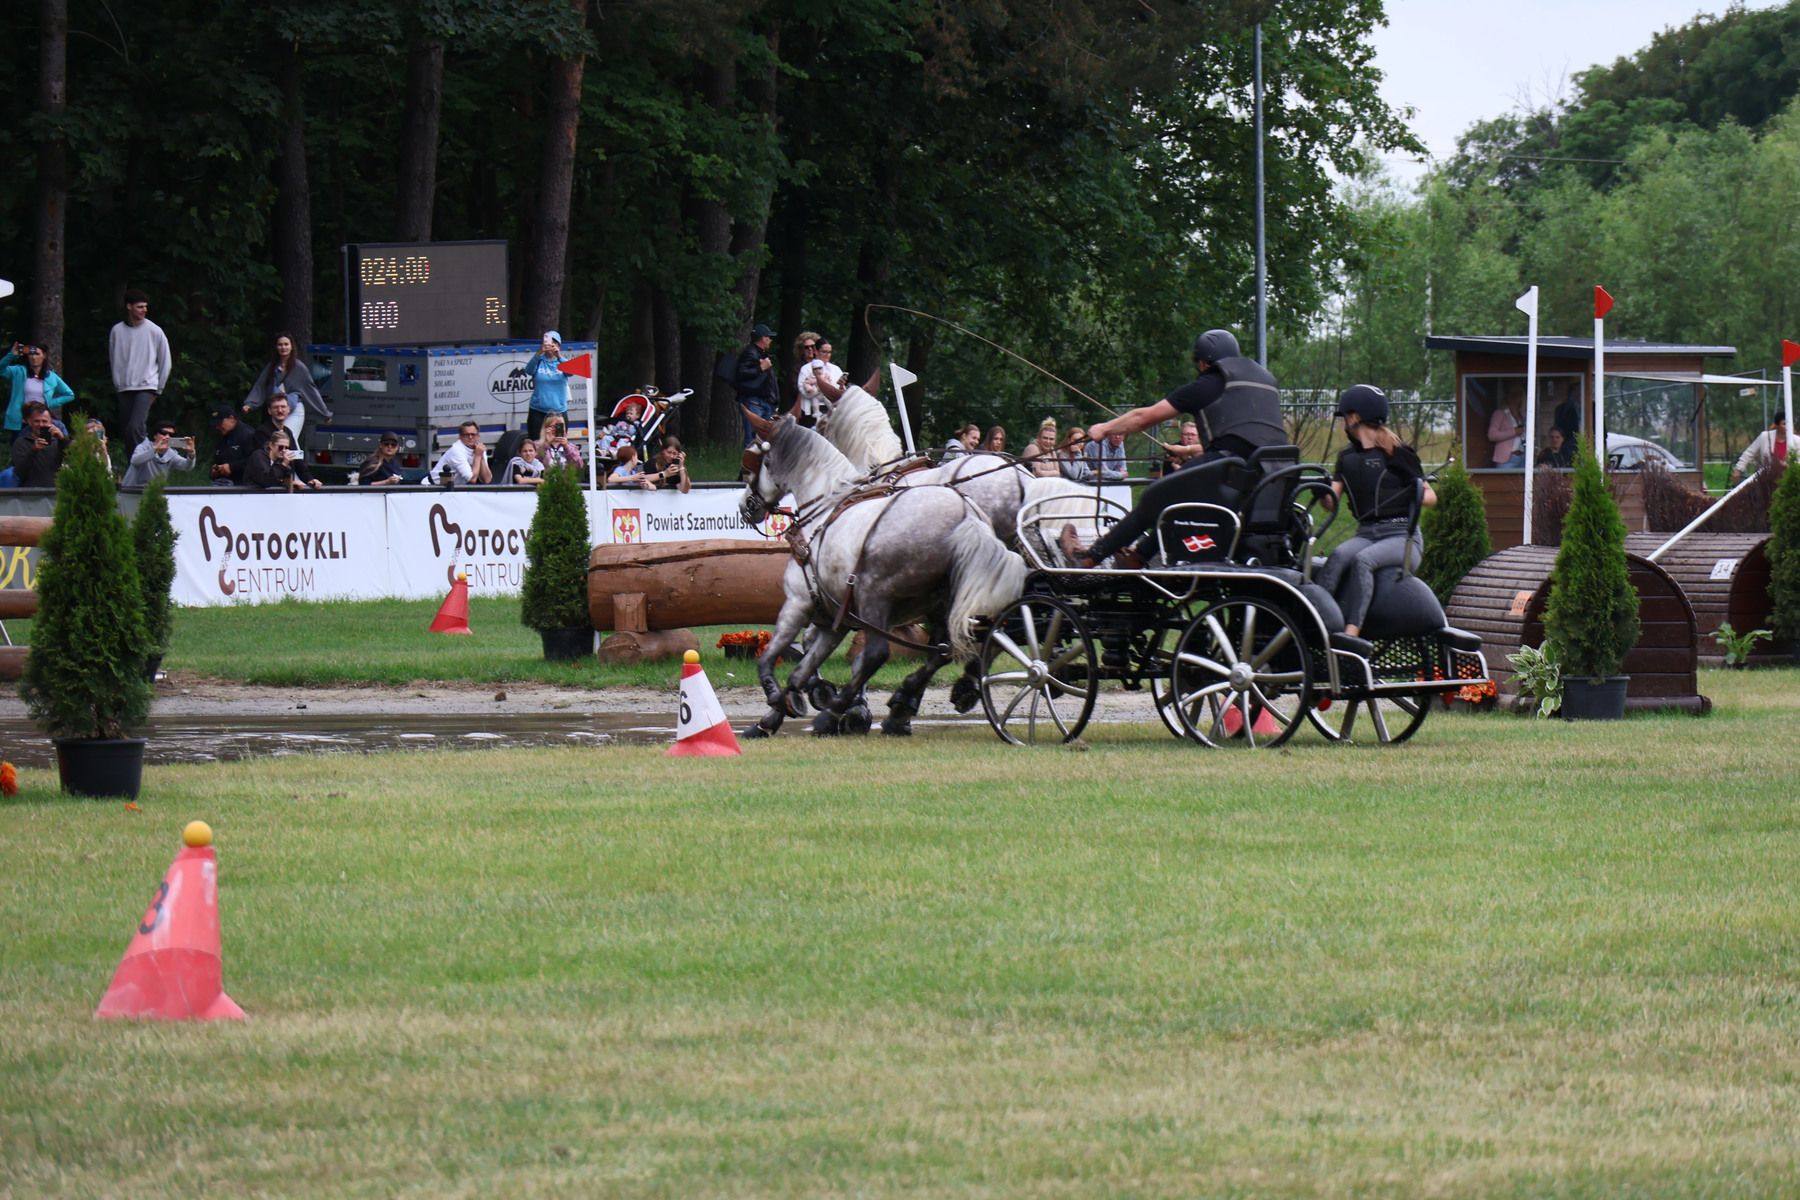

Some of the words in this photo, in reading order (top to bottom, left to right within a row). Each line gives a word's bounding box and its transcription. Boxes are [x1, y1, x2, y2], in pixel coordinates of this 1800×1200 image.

[361, 302, 399, 329] 000
[646, 512, 684, 531] Powiat
[680, 690, 692, 725] 6
